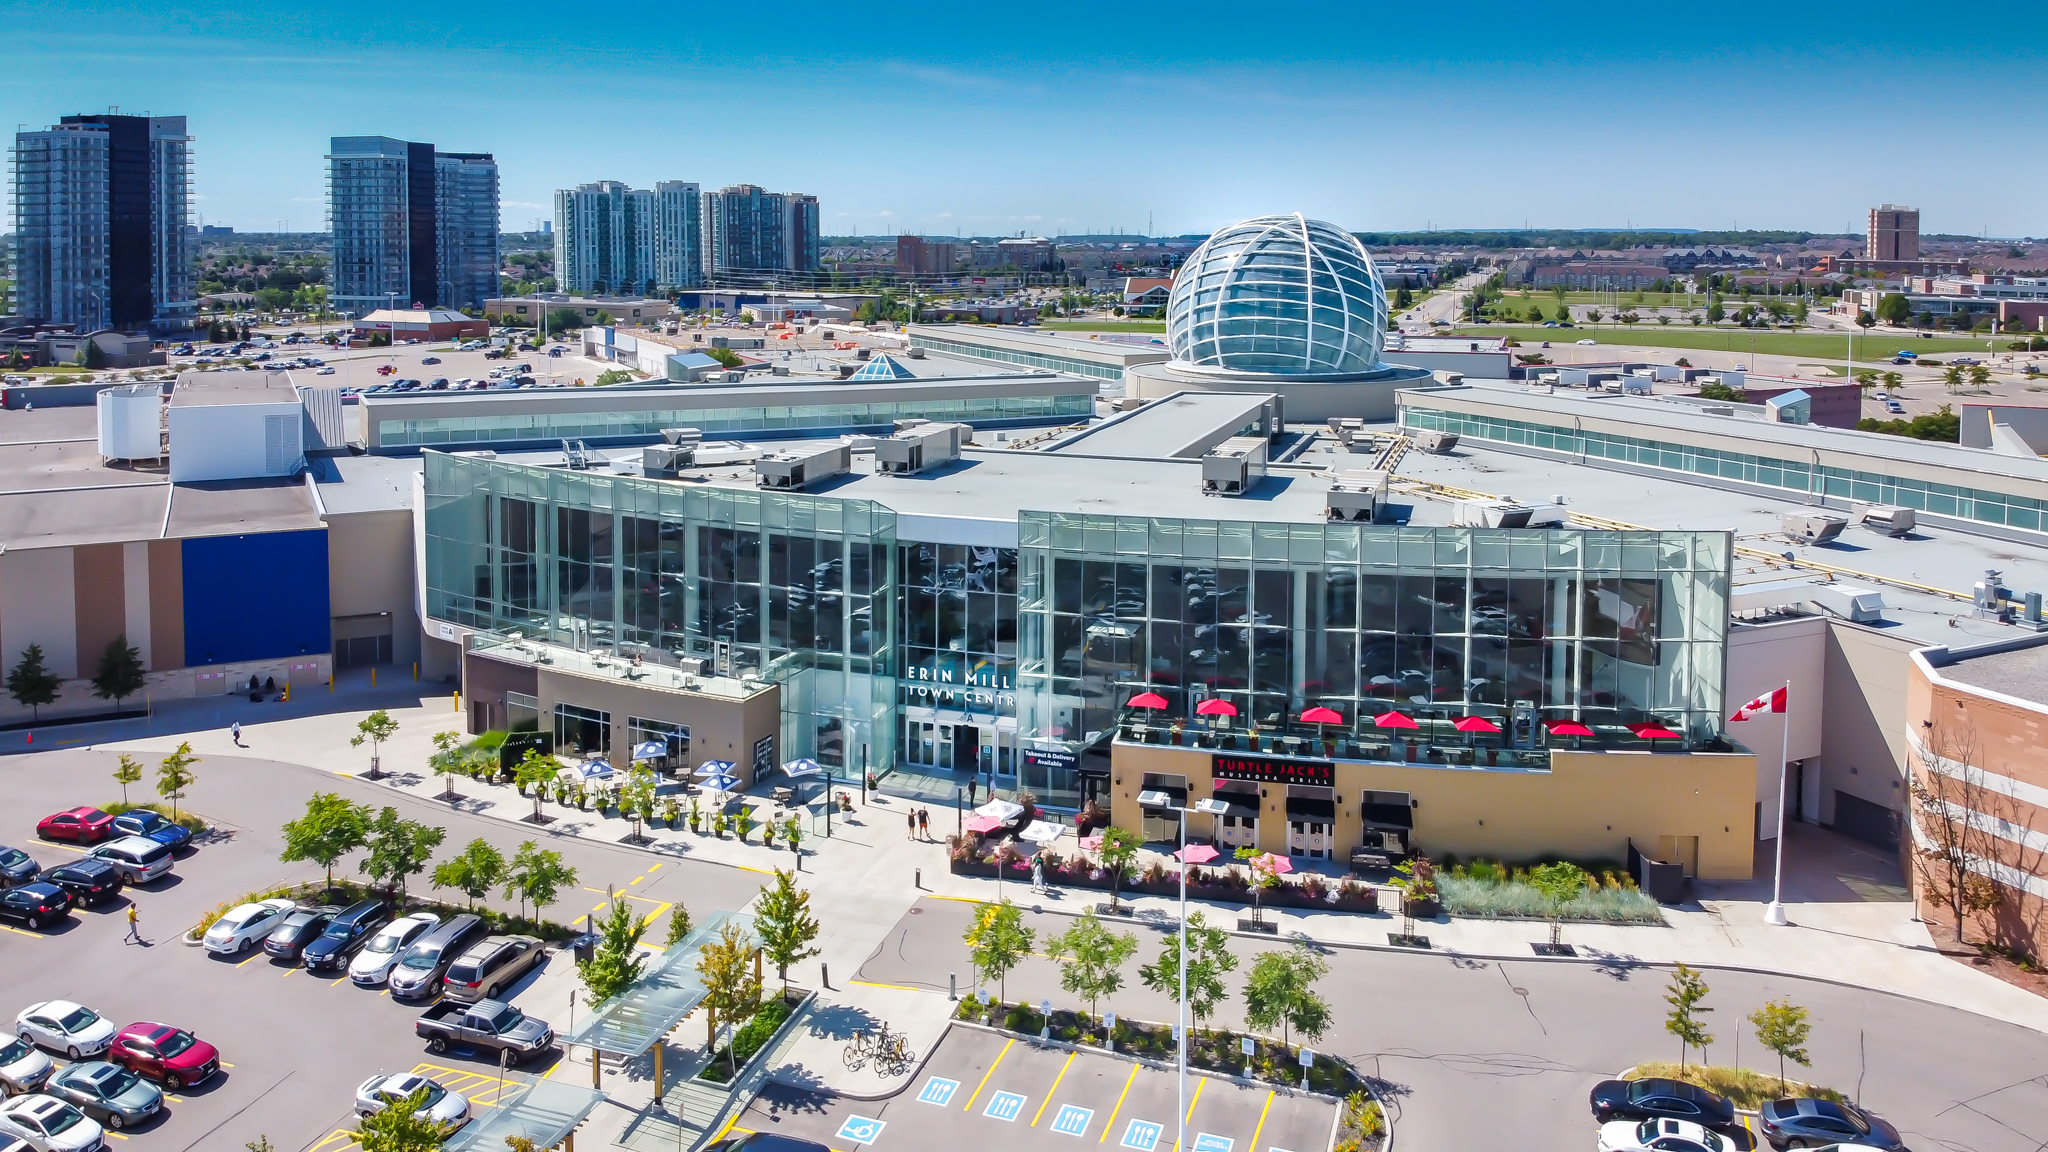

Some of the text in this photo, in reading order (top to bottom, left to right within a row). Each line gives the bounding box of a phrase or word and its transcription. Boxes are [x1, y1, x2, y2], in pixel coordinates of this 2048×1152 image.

[908, 666, 1017, 689] ERIN MILL
[908, 685, 1014, 707] TOWN CENTR
[967, 714, 974, 722] A
[1025, 750, 1047, 758] Takeout
[1052, 754, 1075, 763] Delivery
[1037, 759, 1062, 767] Available
[1218, 760, 1330, 778] TURTLE JACK'S
[1219, 771, 1328, 785] MUSKOKA GRILL
[1199, 1141, 1228, 1149] DELIVERY
